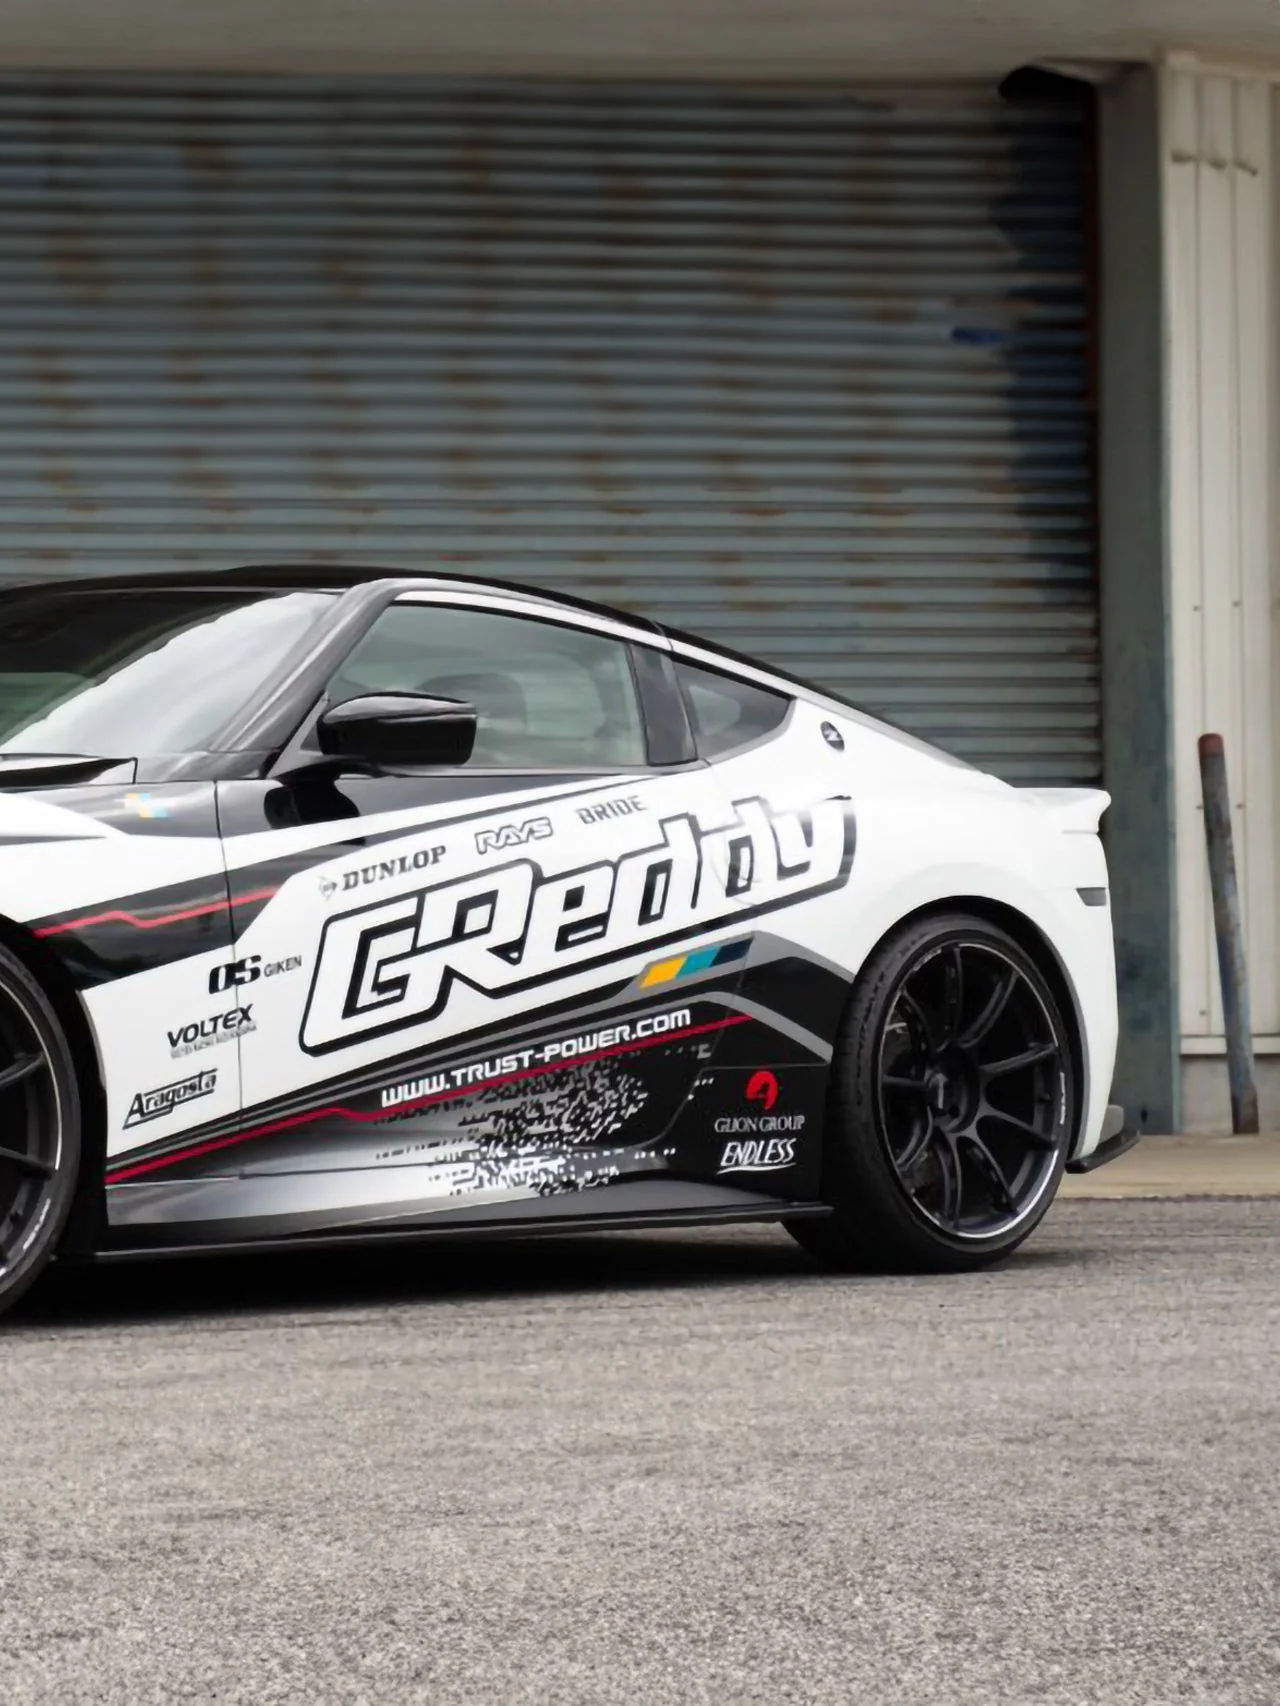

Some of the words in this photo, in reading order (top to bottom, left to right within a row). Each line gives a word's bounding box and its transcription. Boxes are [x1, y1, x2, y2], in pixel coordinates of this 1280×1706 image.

[576, 795, 647, 825] BRIDE
[474, 816, 554, 856] RAYS
[342, 845, 447, 890] DUNLOP
[263, 955, 303, 978] GIKEN
[167, 1003, 254, 1049] VOLTEX
[122, 1068, 218, 1131] Aragosta
[759, 1115, 806, 1132] GROUP
[718, 1138, 798, 1168] ENDLESS
